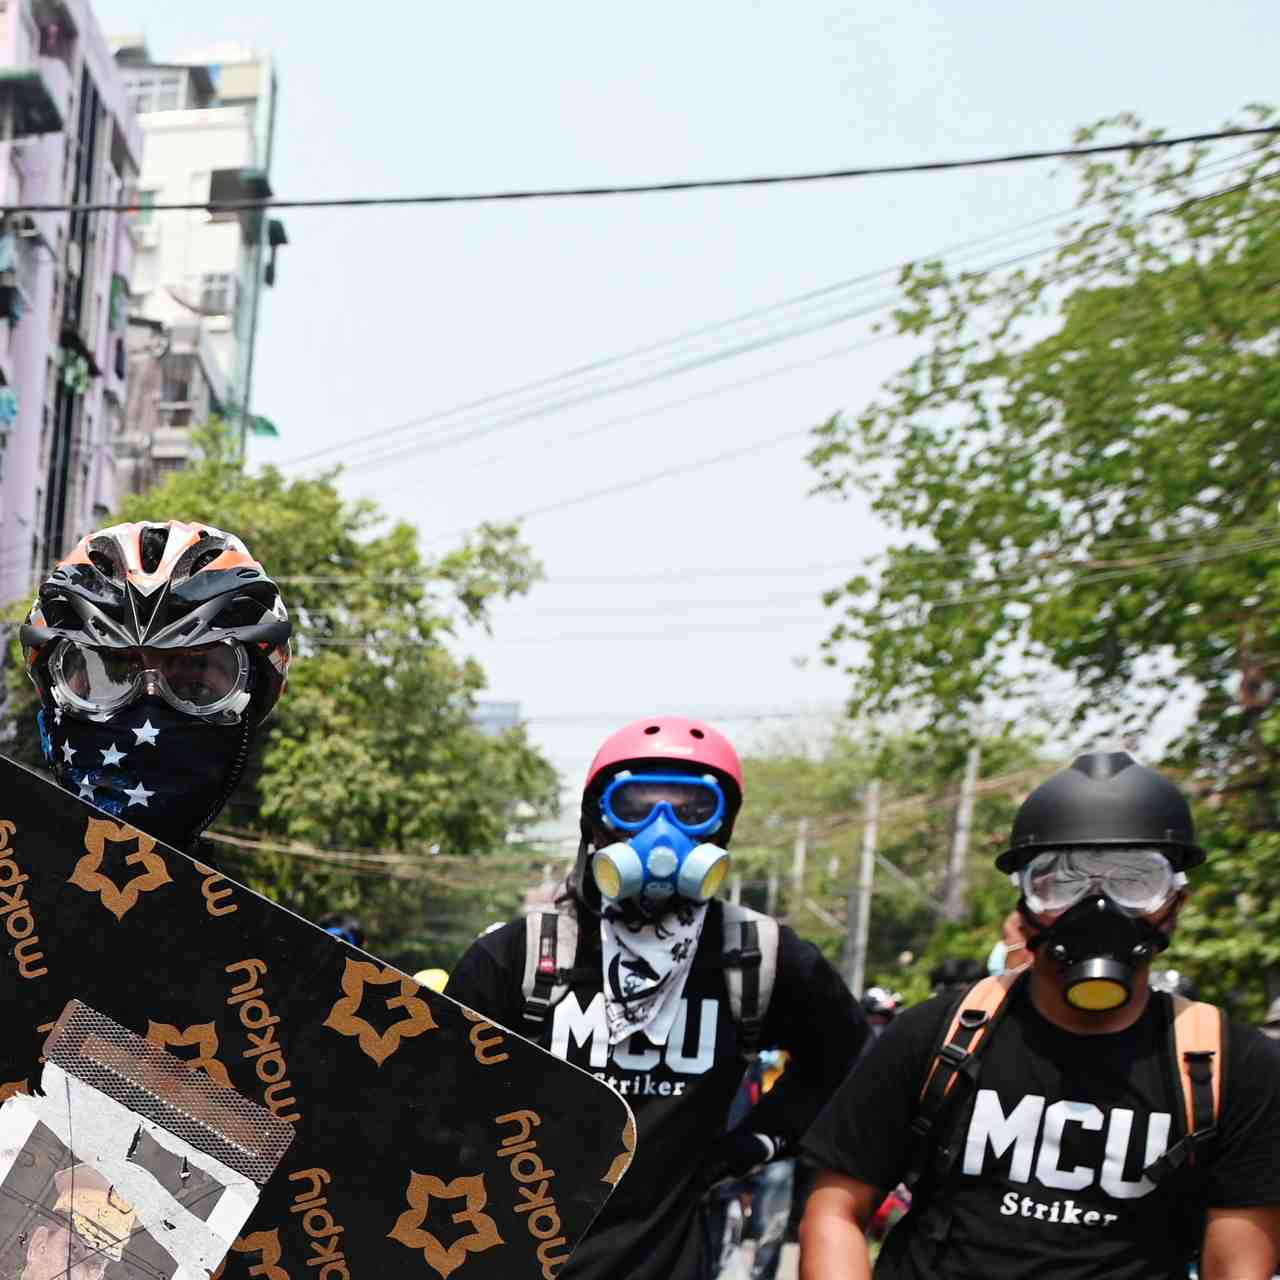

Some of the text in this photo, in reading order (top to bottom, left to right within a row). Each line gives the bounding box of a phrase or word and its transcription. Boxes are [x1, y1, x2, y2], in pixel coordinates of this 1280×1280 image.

[225, 958, 301, 1121] makply
[962, 1089, 1172, 1200] MCU
[1000, 1190, 1118, 1229] Striker
